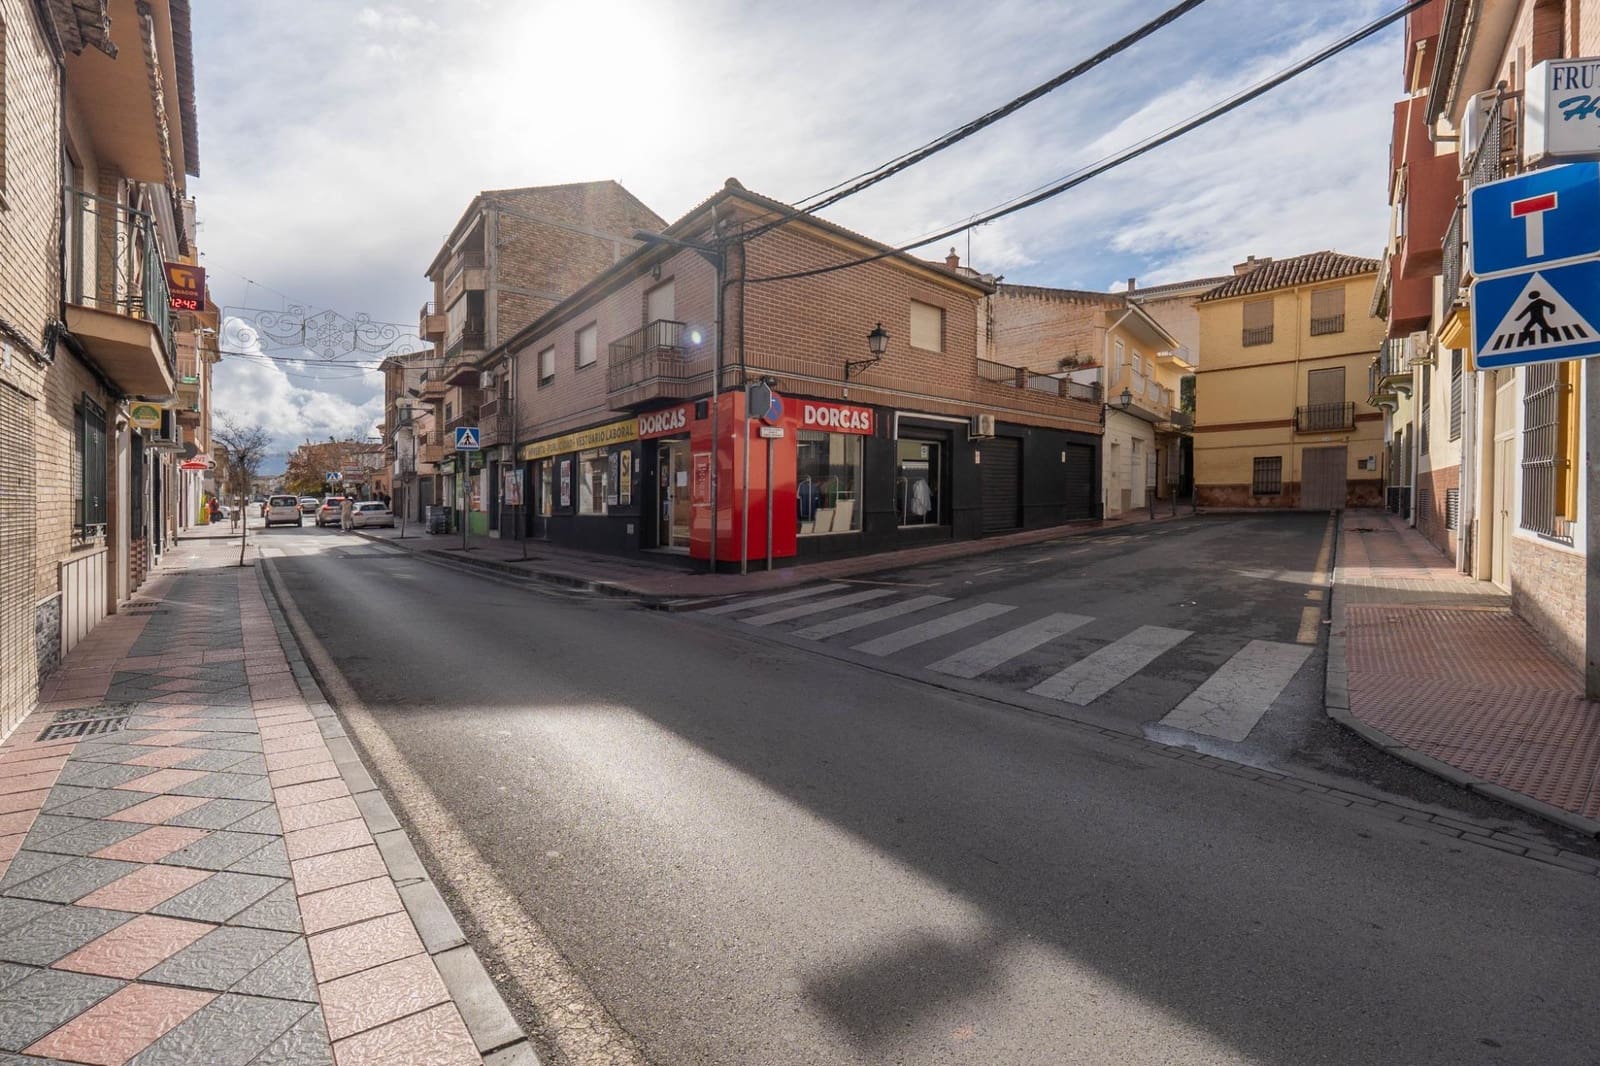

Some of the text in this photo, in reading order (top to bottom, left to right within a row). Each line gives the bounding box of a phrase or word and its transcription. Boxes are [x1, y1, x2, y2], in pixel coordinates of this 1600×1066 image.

[171, 298, 197, 310] 12:42
[639, 408, 686, 435] DORCAS
[804, 405, 869, 430] DORCAS
[576, 431, 605, 446] VESTUARIO
[606, 425, 633, 440] LABORAL
